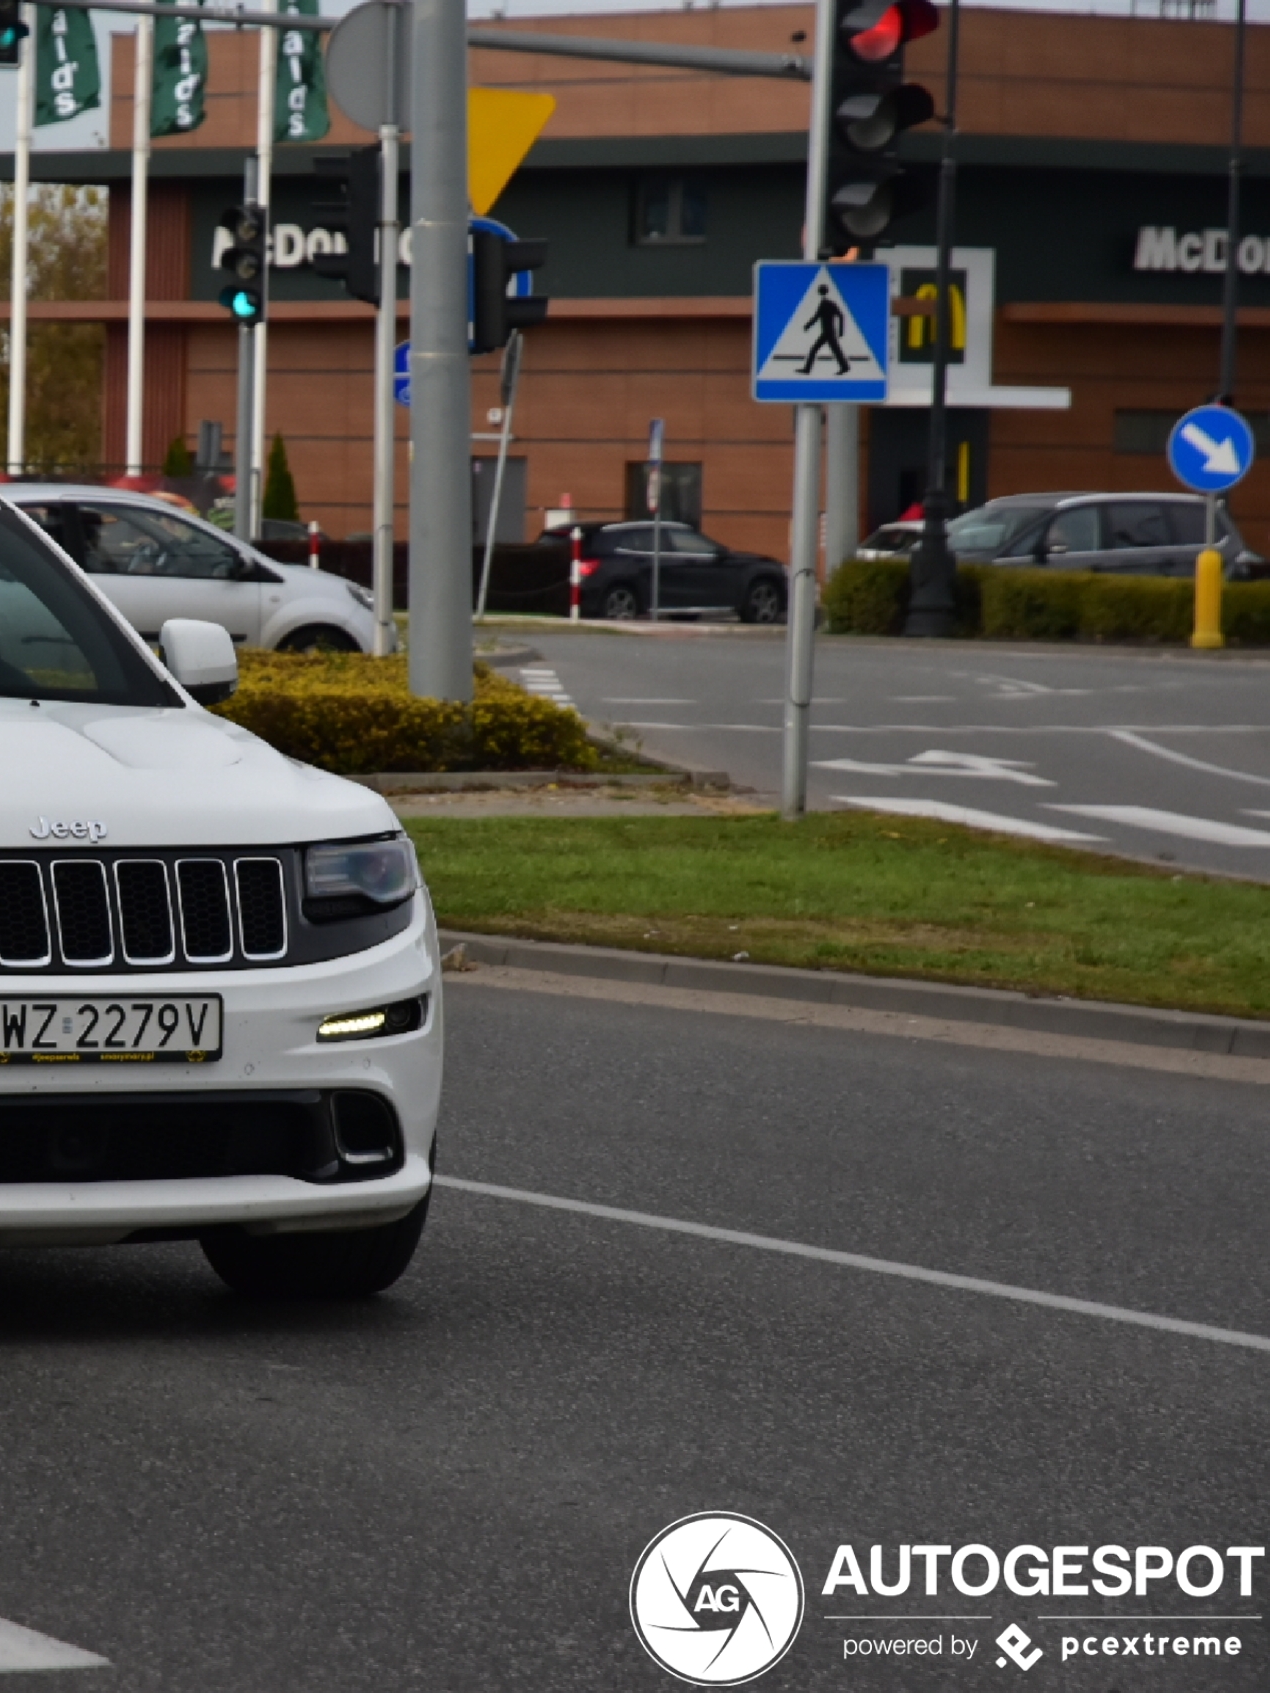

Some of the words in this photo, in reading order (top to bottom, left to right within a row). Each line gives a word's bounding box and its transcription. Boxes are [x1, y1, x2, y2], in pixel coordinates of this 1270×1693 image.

[1133, 225, 1270, 273] McDo
[29, 815, 108, 844] Jeep
[2, 1003, 57, 1048] WZ
[76, 1002, 209, 1048] 2279V
